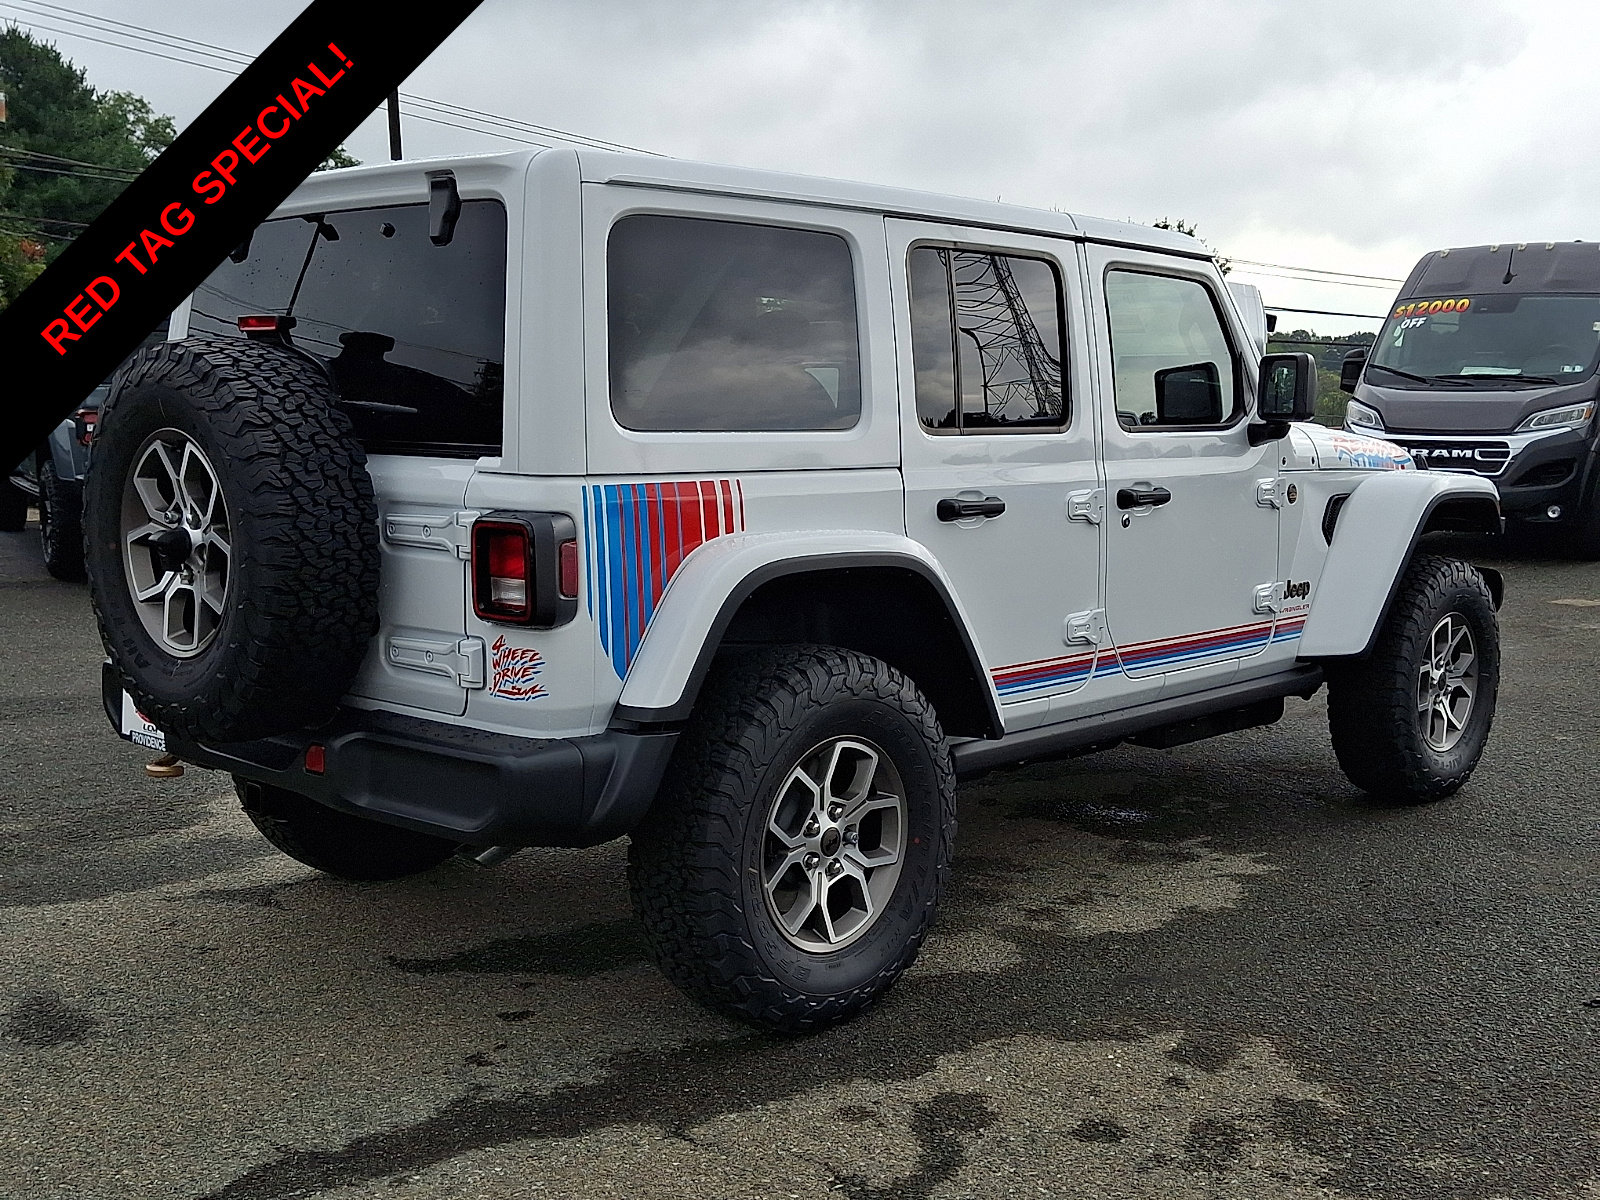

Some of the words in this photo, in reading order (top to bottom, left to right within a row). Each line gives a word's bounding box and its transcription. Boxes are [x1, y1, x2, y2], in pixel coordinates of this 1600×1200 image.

[1393, 298, 1470, 318] $12000
[1401, 317, 1427, 329] OFF
[1410, 448, 1473, 458] RAM
[1283, 580, 1311, 600] Jeep
[492, 634, 507, 655] 4
[492, 648, 543, 670] WHEEL
[493, 666, 538, 692] DRIVE
[131, 731, 167, 752] PROVIDENCE
